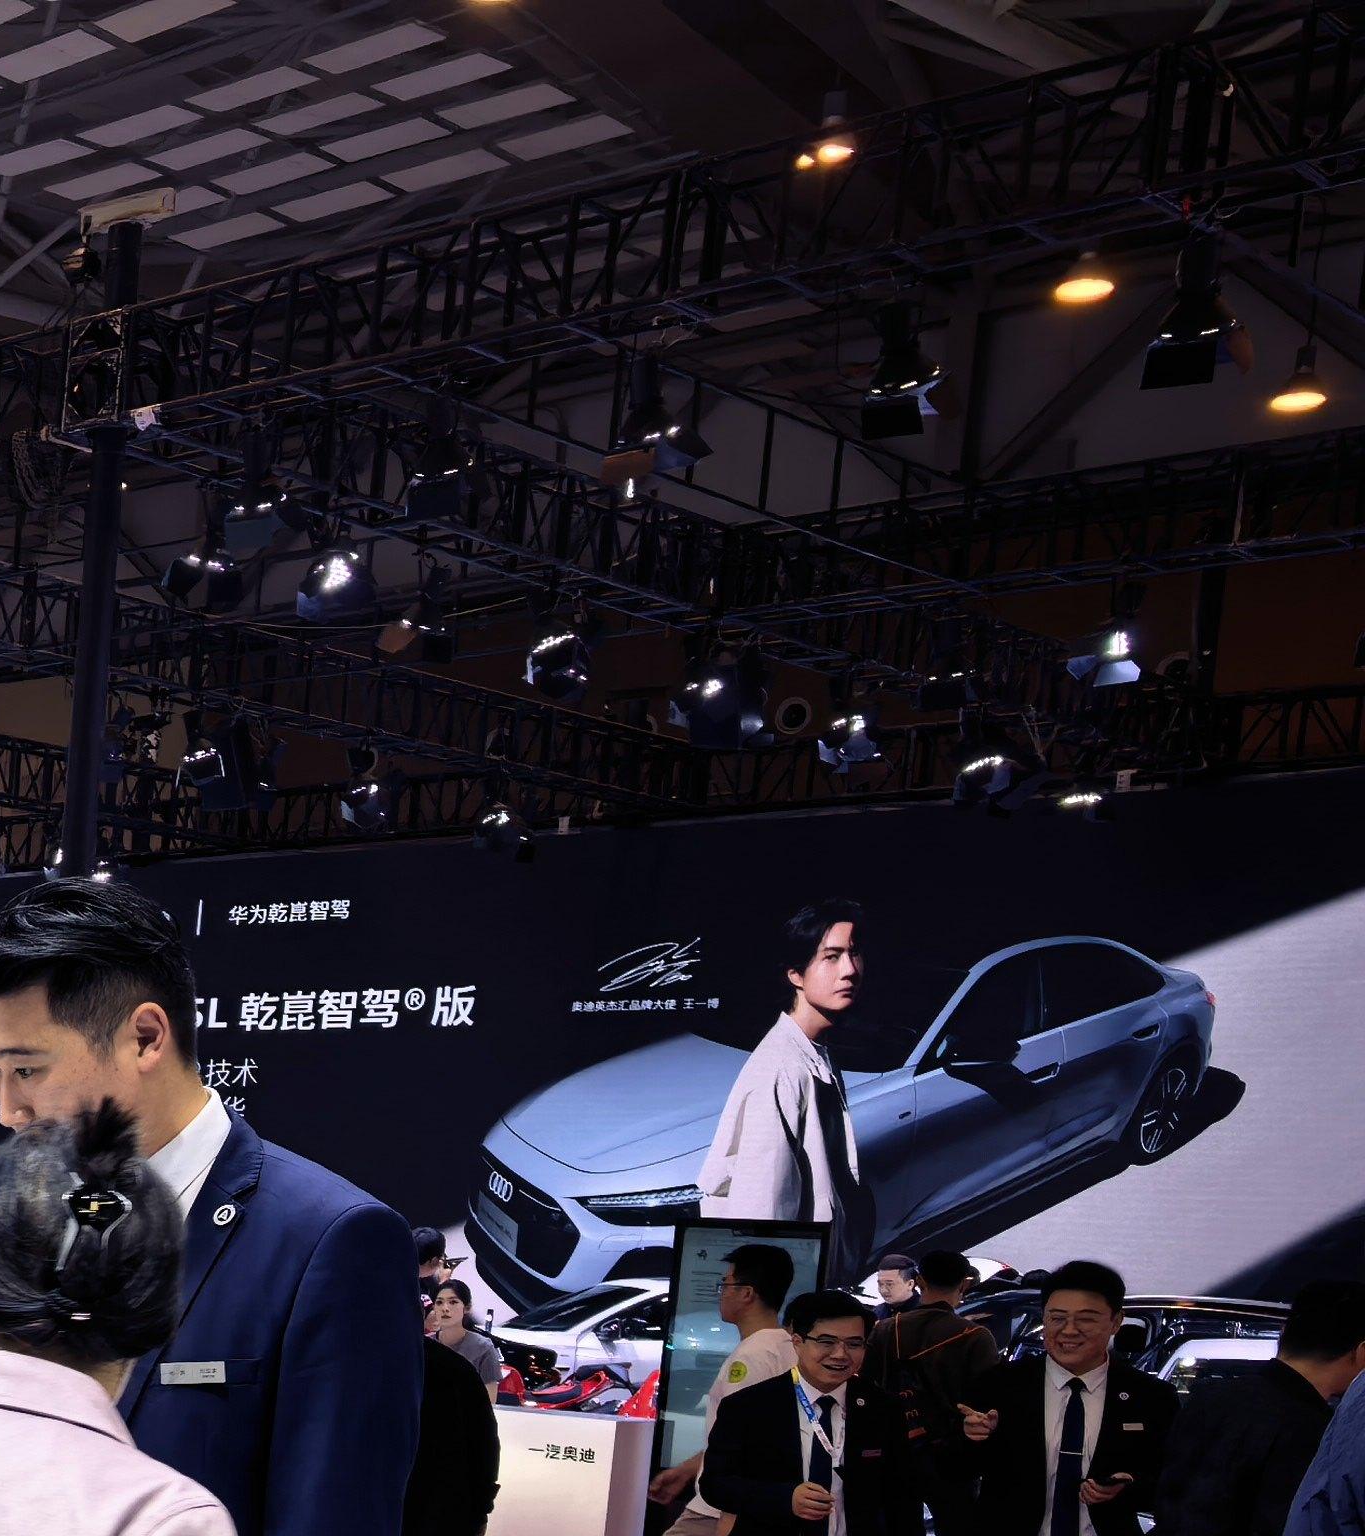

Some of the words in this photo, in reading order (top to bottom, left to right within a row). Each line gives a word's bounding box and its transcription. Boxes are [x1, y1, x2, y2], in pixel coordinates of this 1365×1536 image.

[205, 1058, 259, 1088] 技术
[528, 1443, 596, 1464] 一汽奥迪
